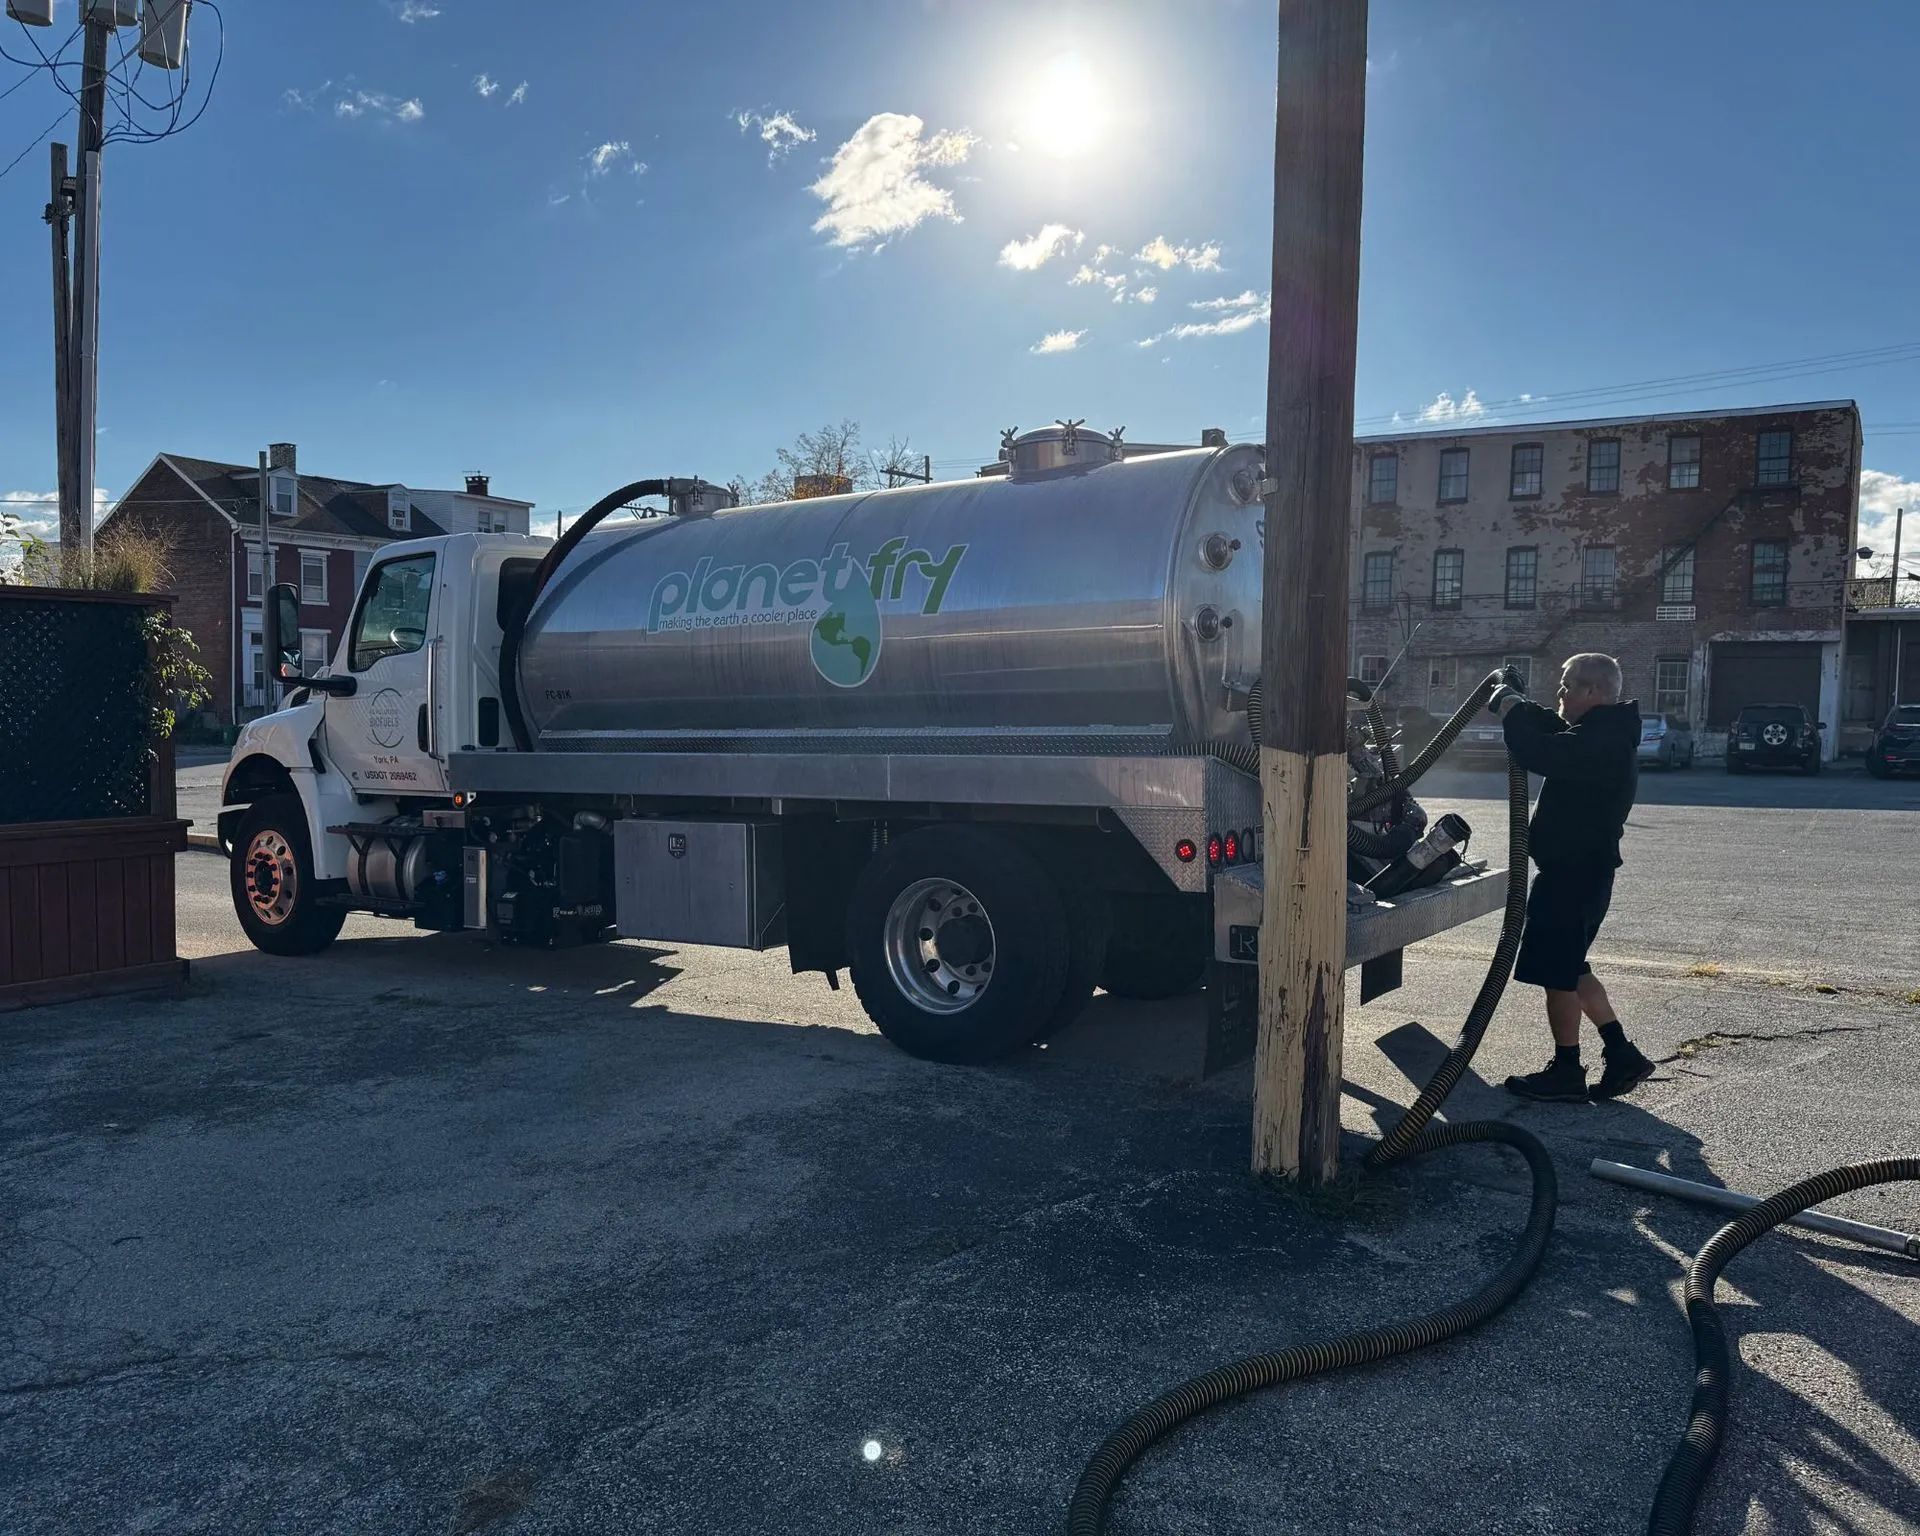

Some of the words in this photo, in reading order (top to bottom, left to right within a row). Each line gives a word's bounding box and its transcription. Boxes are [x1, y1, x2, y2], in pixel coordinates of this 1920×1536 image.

[648, 541, 850, 634] planet
[866, 535, 970, 617] fry
[659, 615, 692, 631] making
[695, 614, 711, 628] the
[713, 612, 740, 626] earth
[741, 614, 748, 624] a
[751, 609, 784, 624] cooler
[787, 607, 818, 625] place
[364, 769, 388, 781] USDOT
